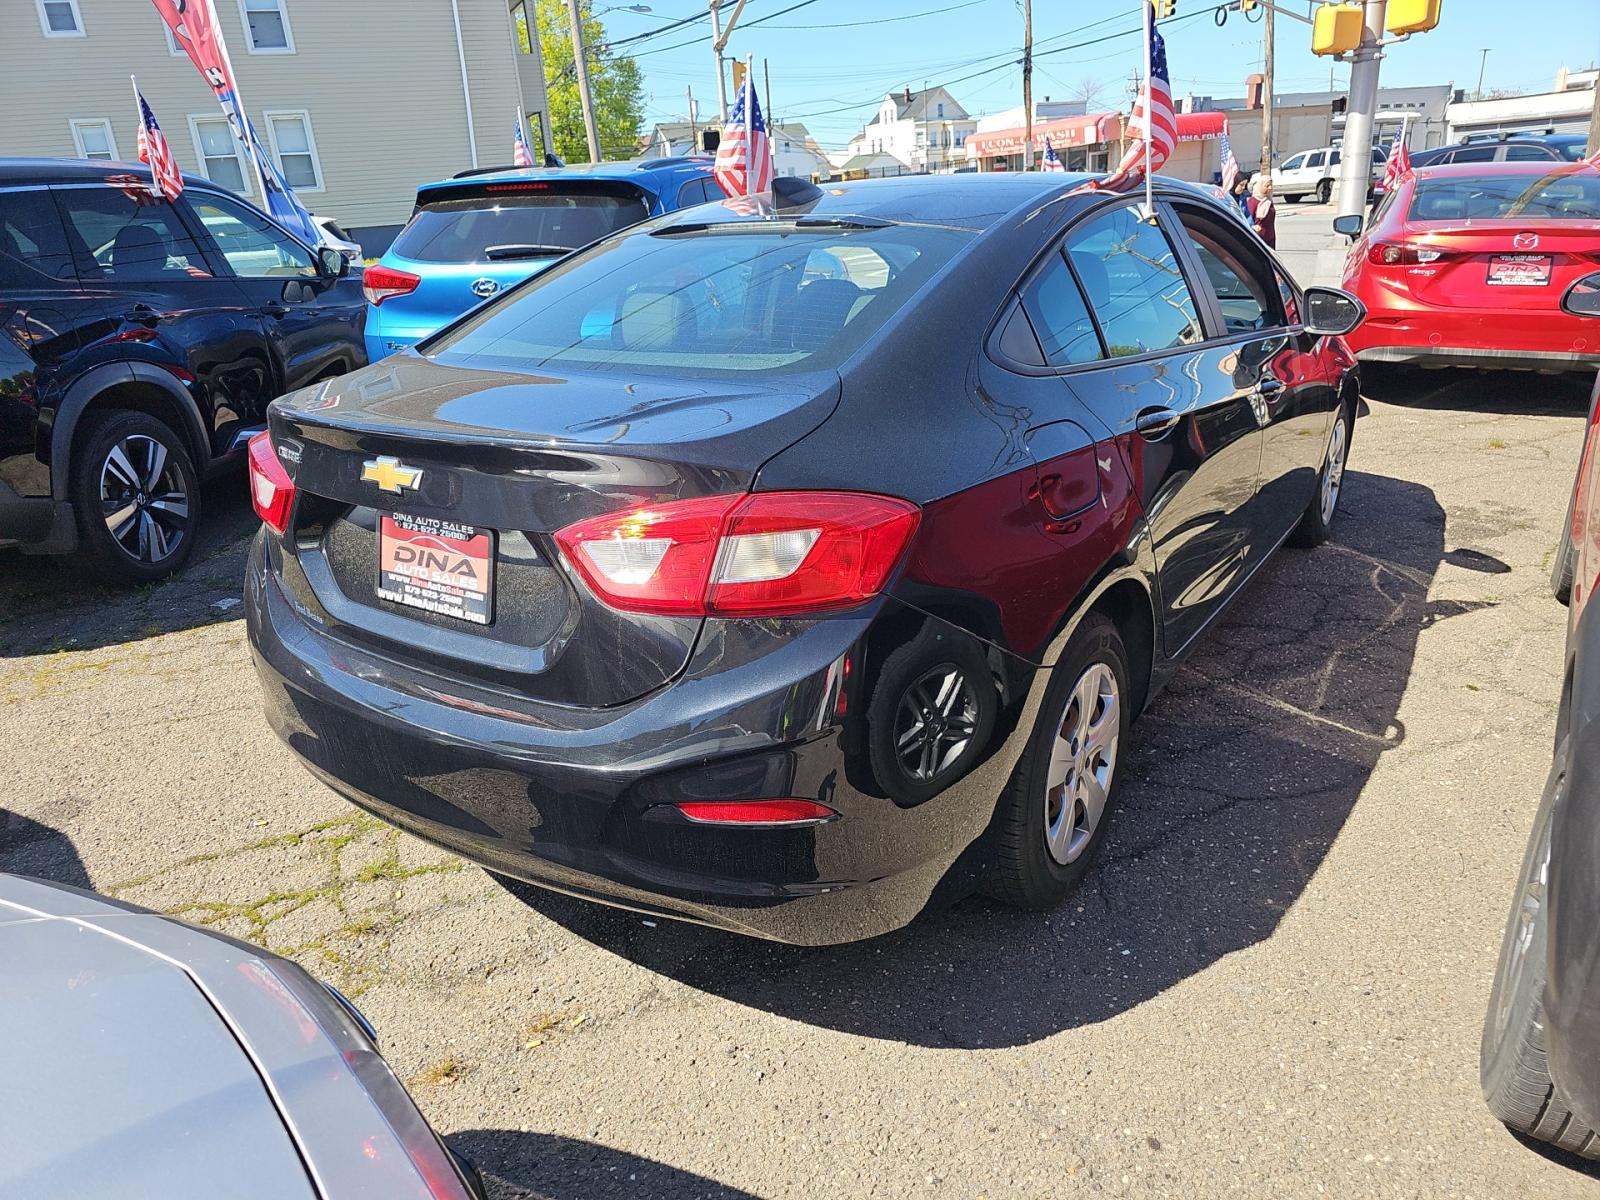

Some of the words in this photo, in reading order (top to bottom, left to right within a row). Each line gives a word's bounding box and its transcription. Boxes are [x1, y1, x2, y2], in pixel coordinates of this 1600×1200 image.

[392, 512, 412, 522] DINA
[415, 516, 440, 527] AUTO
[442, 521, 474, 534] SALES
[393, 562, 429, 578] AUTO
[431, 571, 478, 590] SALES
[394, 546, 477, 578] DINA
